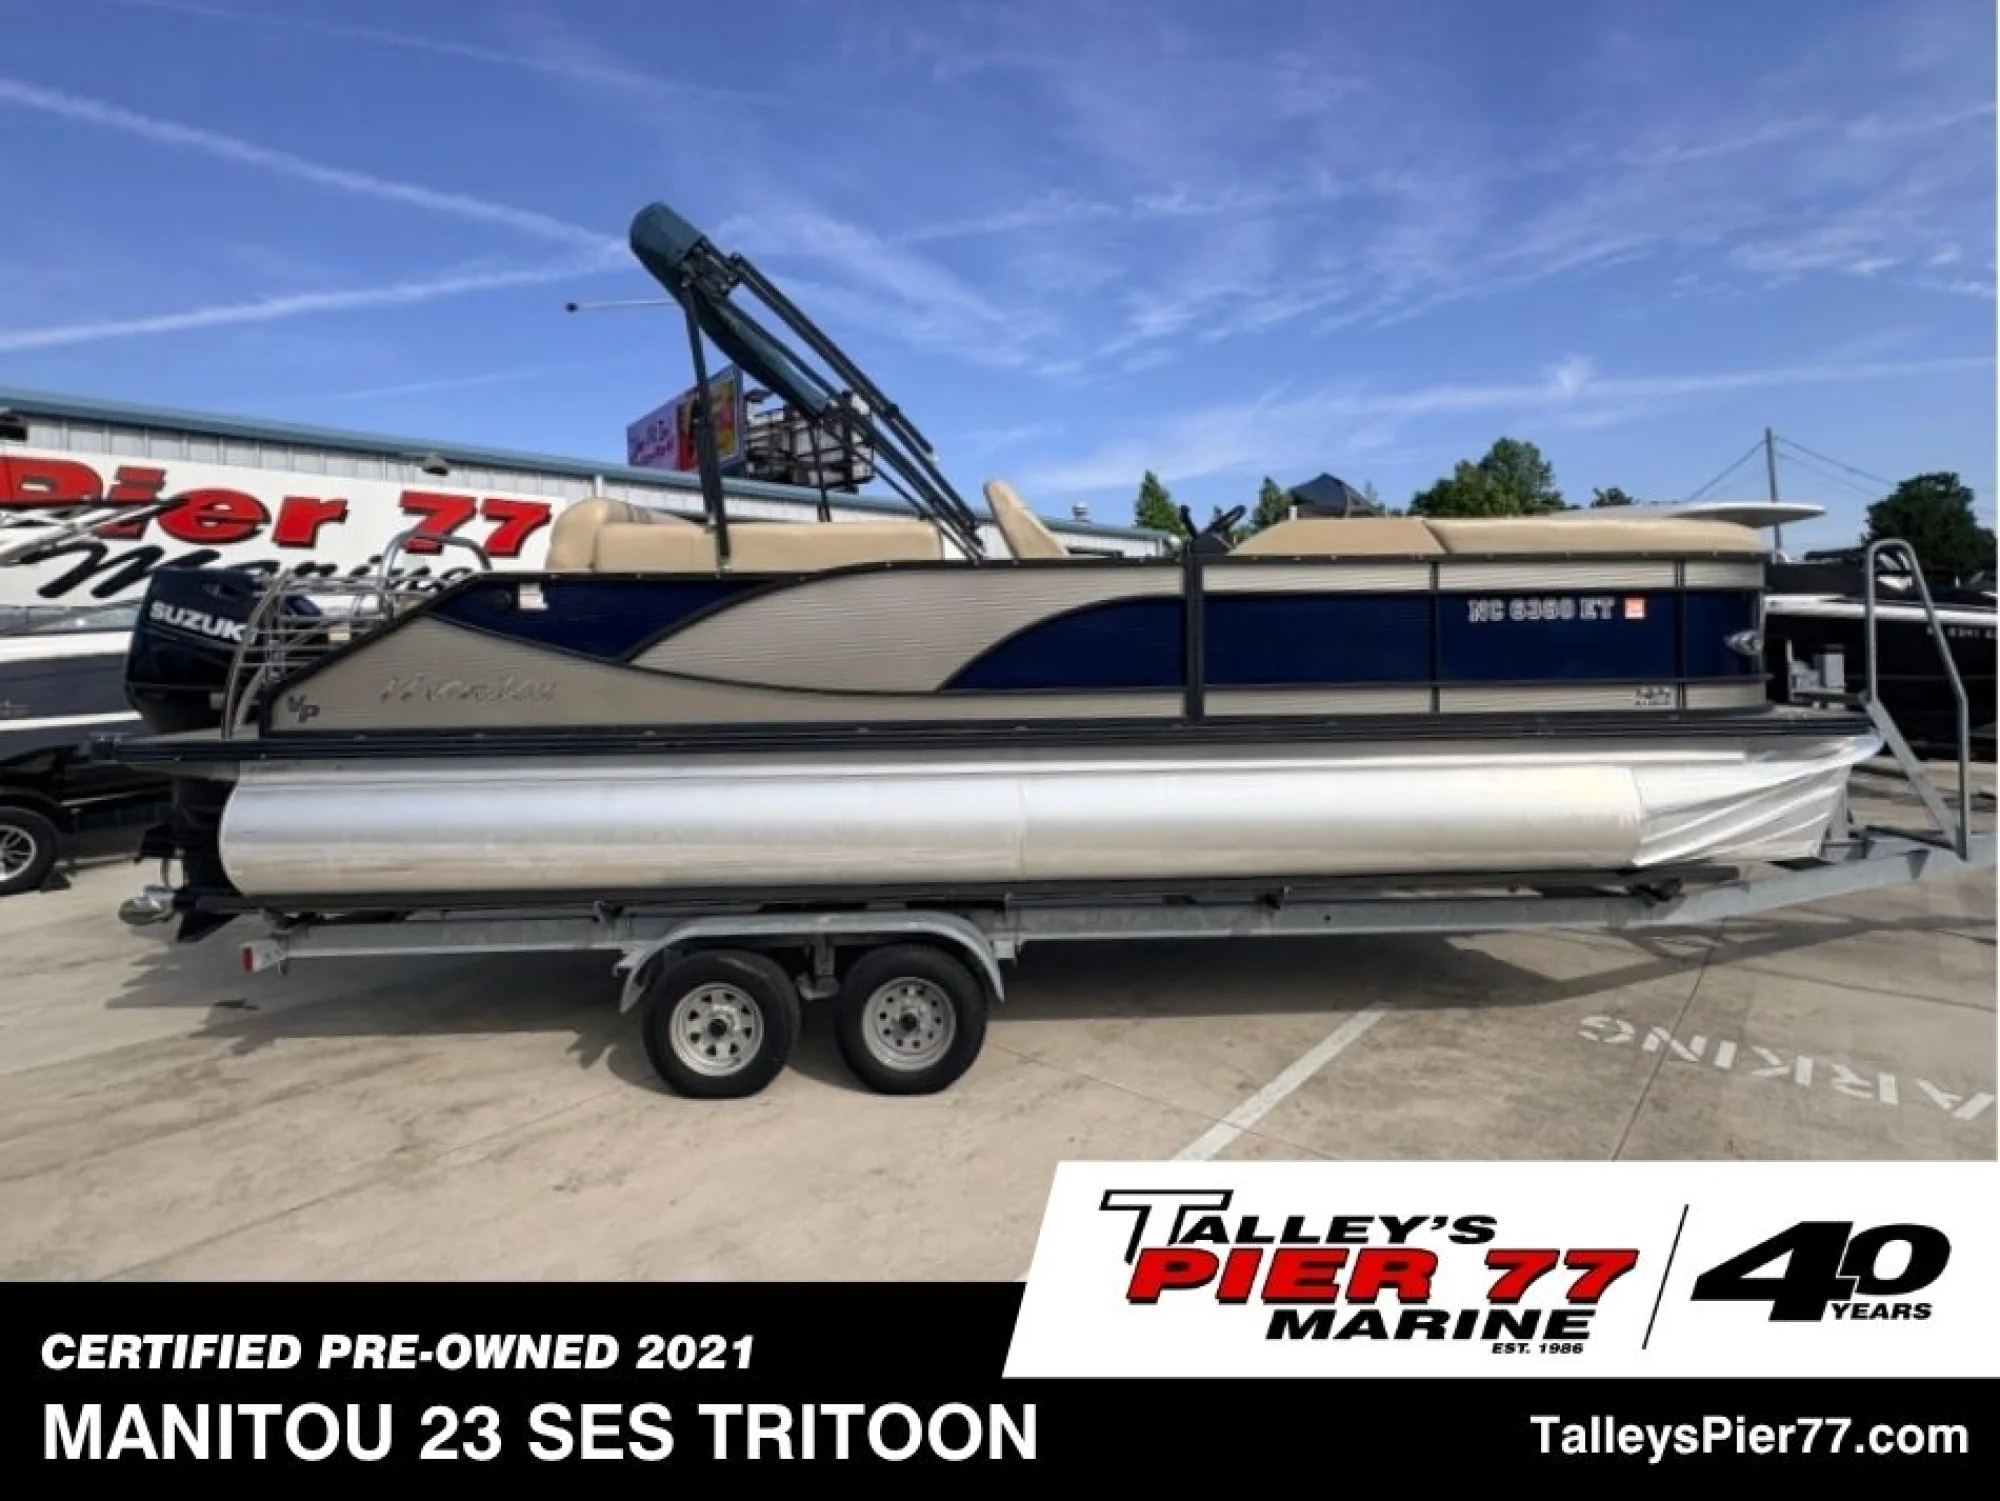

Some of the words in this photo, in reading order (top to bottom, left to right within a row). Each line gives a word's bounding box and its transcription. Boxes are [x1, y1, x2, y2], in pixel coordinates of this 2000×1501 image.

[0, 456, 349, 549] Pier
[399, 490, 553, 557] 77
[150, 600, 257, 645] SUZUK
